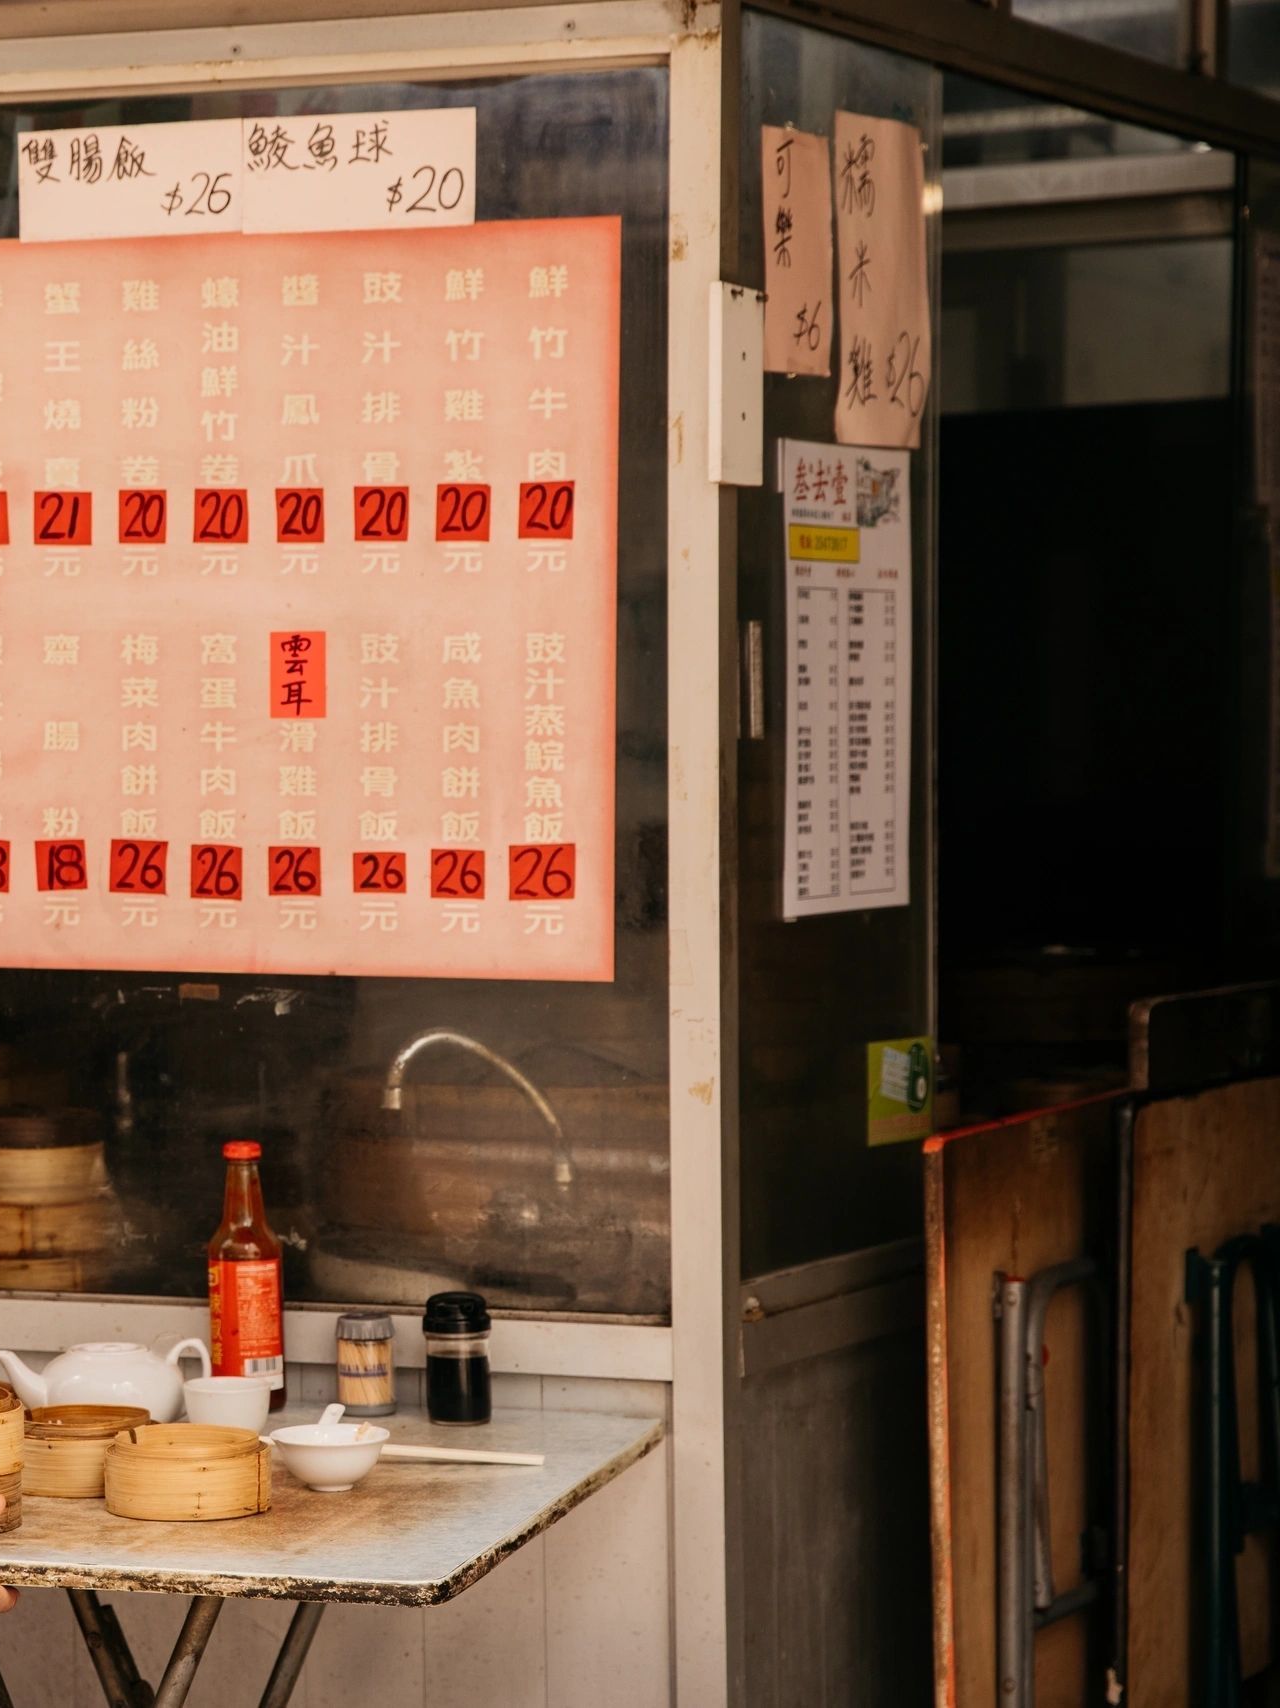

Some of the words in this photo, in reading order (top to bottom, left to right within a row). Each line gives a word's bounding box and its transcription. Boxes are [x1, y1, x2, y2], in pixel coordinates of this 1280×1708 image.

[21, 132, 157, 185] 雙腸飯
[245, 119, 394, 172] 鯪魚球
[160, 172, 233, 216] $26
[385, 165, 465, 213] $20
[773, 138, 795, 268] 可樂
[793, 301, 822, 351] $6
[122, 280, 158, 486] 雞絲粉卷
[201, 276, 238, 485] 蠔油鮮竹卷
[362, 271, 401, 483] 豉汁排骨
[528, 264, 568, 480] 鮮竹牛肉
[884, 330, 925, 417] $26
[39, 492, 78, 539] 21
[124, 491, 163, 537] 20
[199, 491, 241, 538] 20
[279, 492, 320, 534] 20
[359, 488, 405, 536] 20
[441, 486, 485, 532] 20
[526, 483, 572, 530] 20
[44, 549, 81, 577] 元
[123, 547, 159, 576] 元
[201, 547, 239, 575] 元
[283, 546, 318, 574] 元
[363, 545, 400, 573] 元
[445, 543, 482, 573] 元
[528, 542, 567, 572] 元
[280, 634, 313, 717] 雲耳
[43, 634, 78, 838] 齋腸粉
[121, 634, 157, 837] 梅菜肉餅飯
[199, 633, 236, 839] 窩蛋牛肉飯
[359, 633, 397, 841] 豉汁排骨飯
[442, 632, 480, 843] 咸魚肉餅飯
[47, 844, 83, 890] 18
[115, 842, 162, 889] 26
[195, 846, 238, 896] 26
[272, 847, 315, 892] 26
[359, 853, 402, 888] 26
[434, 850, 480, 894] 26
[514, 847, 570, 896] 26
[45, 897, 80, 926] 元
[123, 898, 158, 927] 元
[200, 900, 237, 928] 元
[280, 901, 316, 929] 元
[360, 902, 398, 930] 元
[442, 903, 481, 933] 元
[525, 905, 564, 935] 元
